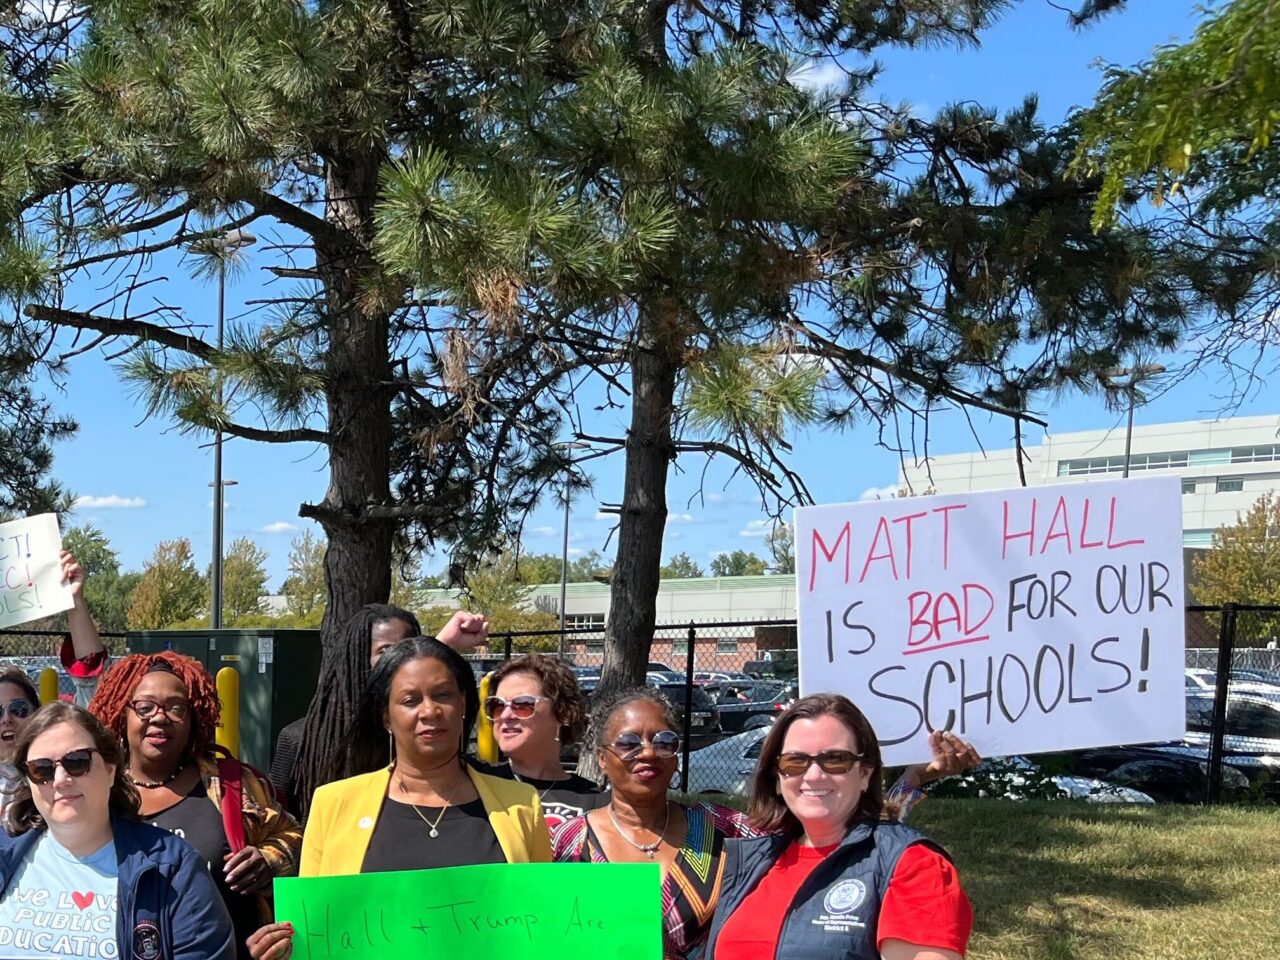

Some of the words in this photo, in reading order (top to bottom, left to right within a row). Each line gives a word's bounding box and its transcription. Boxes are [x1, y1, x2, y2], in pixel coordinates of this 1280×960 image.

[809, 503, 968, 592] MATT
[1001, 495, 1146, 560] HALL
[825, 600, 876, 663] IS
[905, 582, 995, 652] BAD
[1007, 569, 1077, 632] FOR
[1095, 561, 1173, 615] OUR
[867, 627, 1150, 747] SCHOOLS!
[302, 899, 391, 960] Hall
[426, 900, 539, 939] Trump
[564, 895, 606, 936] Are
